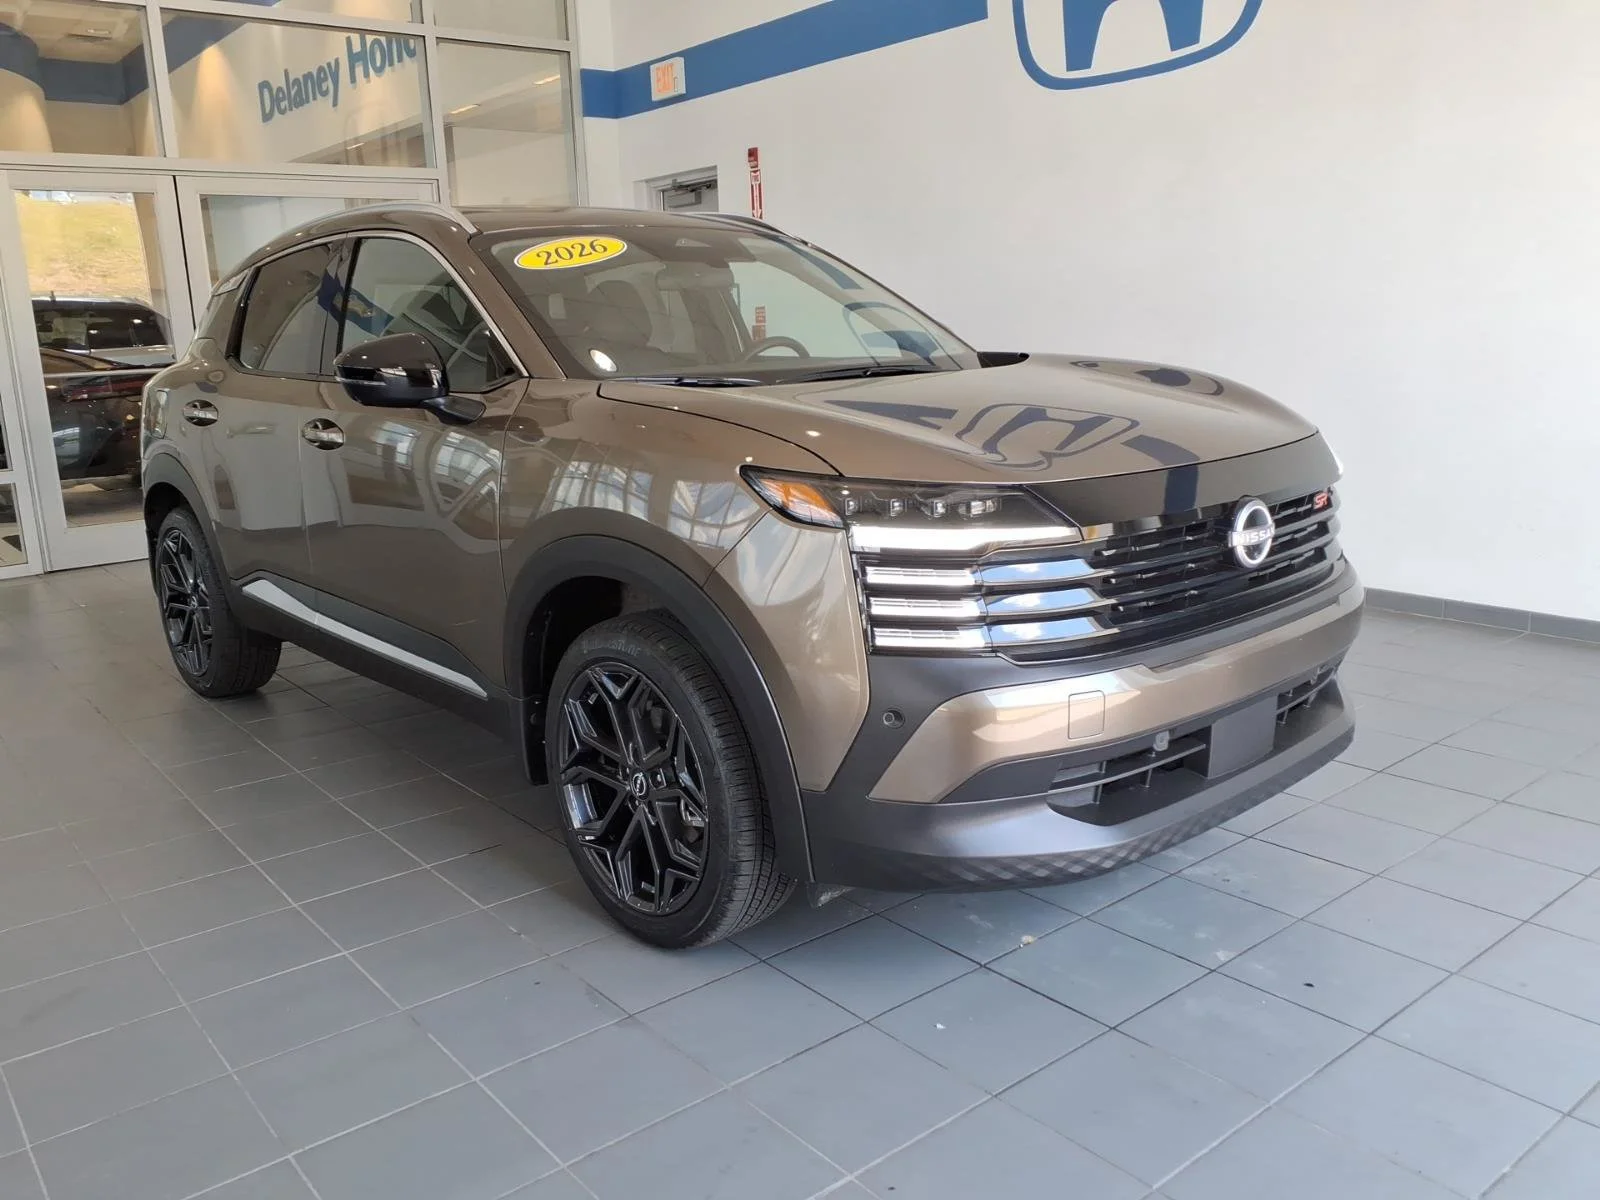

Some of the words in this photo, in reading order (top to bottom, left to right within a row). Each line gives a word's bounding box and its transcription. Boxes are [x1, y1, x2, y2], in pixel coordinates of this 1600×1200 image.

[257, 57, 340, 123] Delaney
[536, 239, 608, 266] 2026
[1313, 491, 1329, 510] SR
